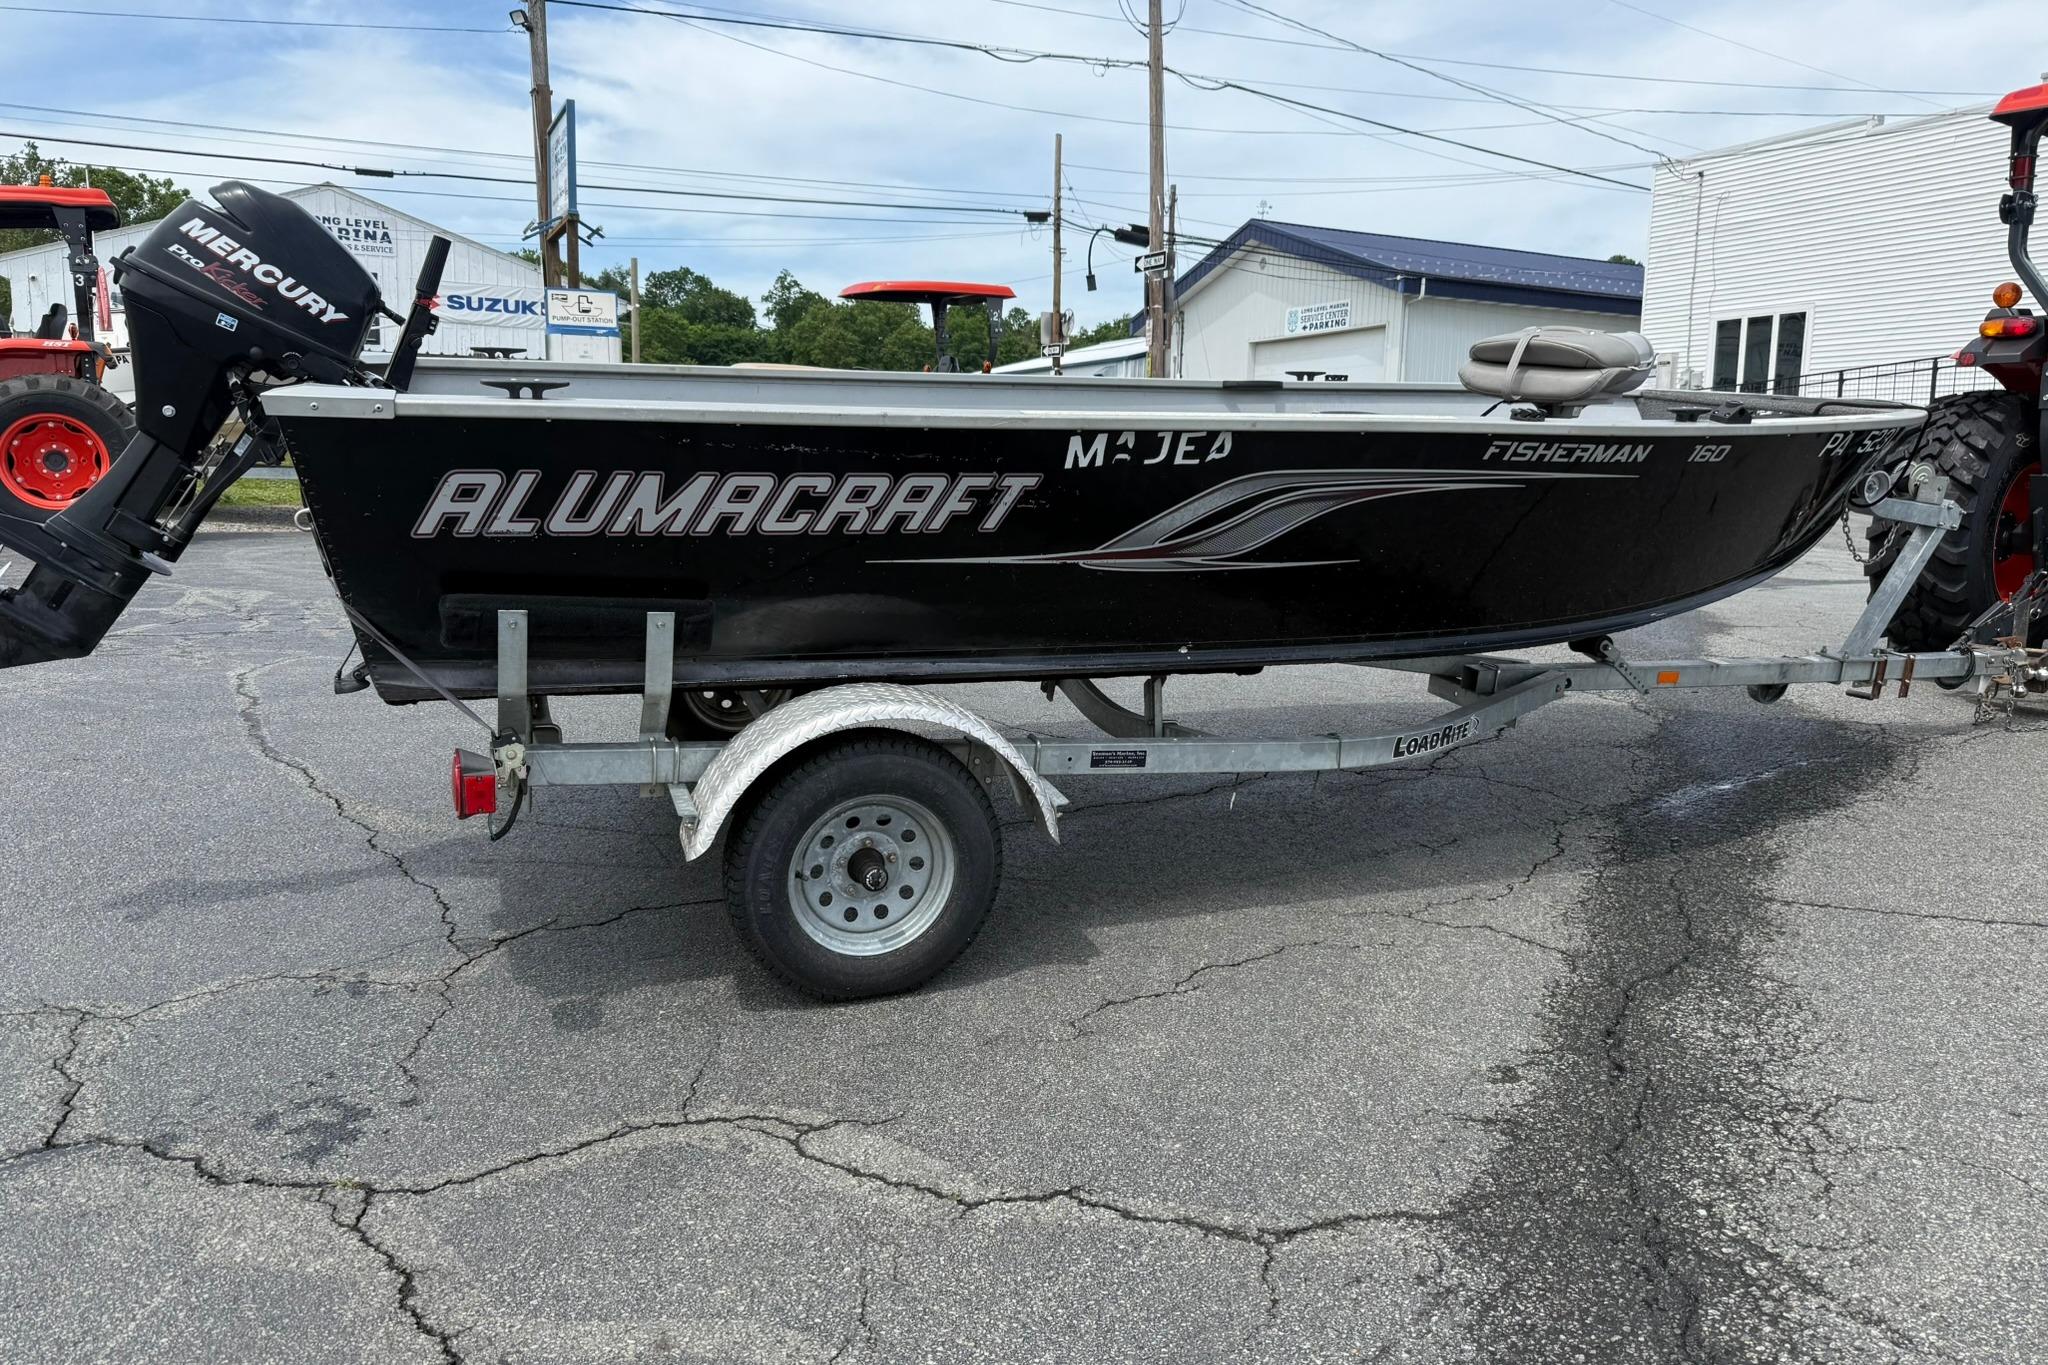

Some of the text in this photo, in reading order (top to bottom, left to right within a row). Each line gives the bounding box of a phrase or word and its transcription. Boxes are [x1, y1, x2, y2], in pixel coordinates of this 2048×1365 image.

[315, 215, 389, 230] NG LEVEL
[327, 226, 392, 245] RINA
[167, 243, 206, 269] Pro
[361, 244, 394, 254] SERVICE
[179, 217, 350, 324] MERCURY
[75, 274, 85, 287] 3
[552, 315, 614, 325] PUMP-OUT STATION
[1300, 309, 1349, 324] SERVICE CENTER
[1309, 319, 1346, 331] PARKING
[116, 355, 130, 365] PA
[1818, 430, 1855, 458] PA
[1482, 440, 1732, 464] FISHERMAN 160
[411, 469, 1044, 538] ALUMACRAFT
